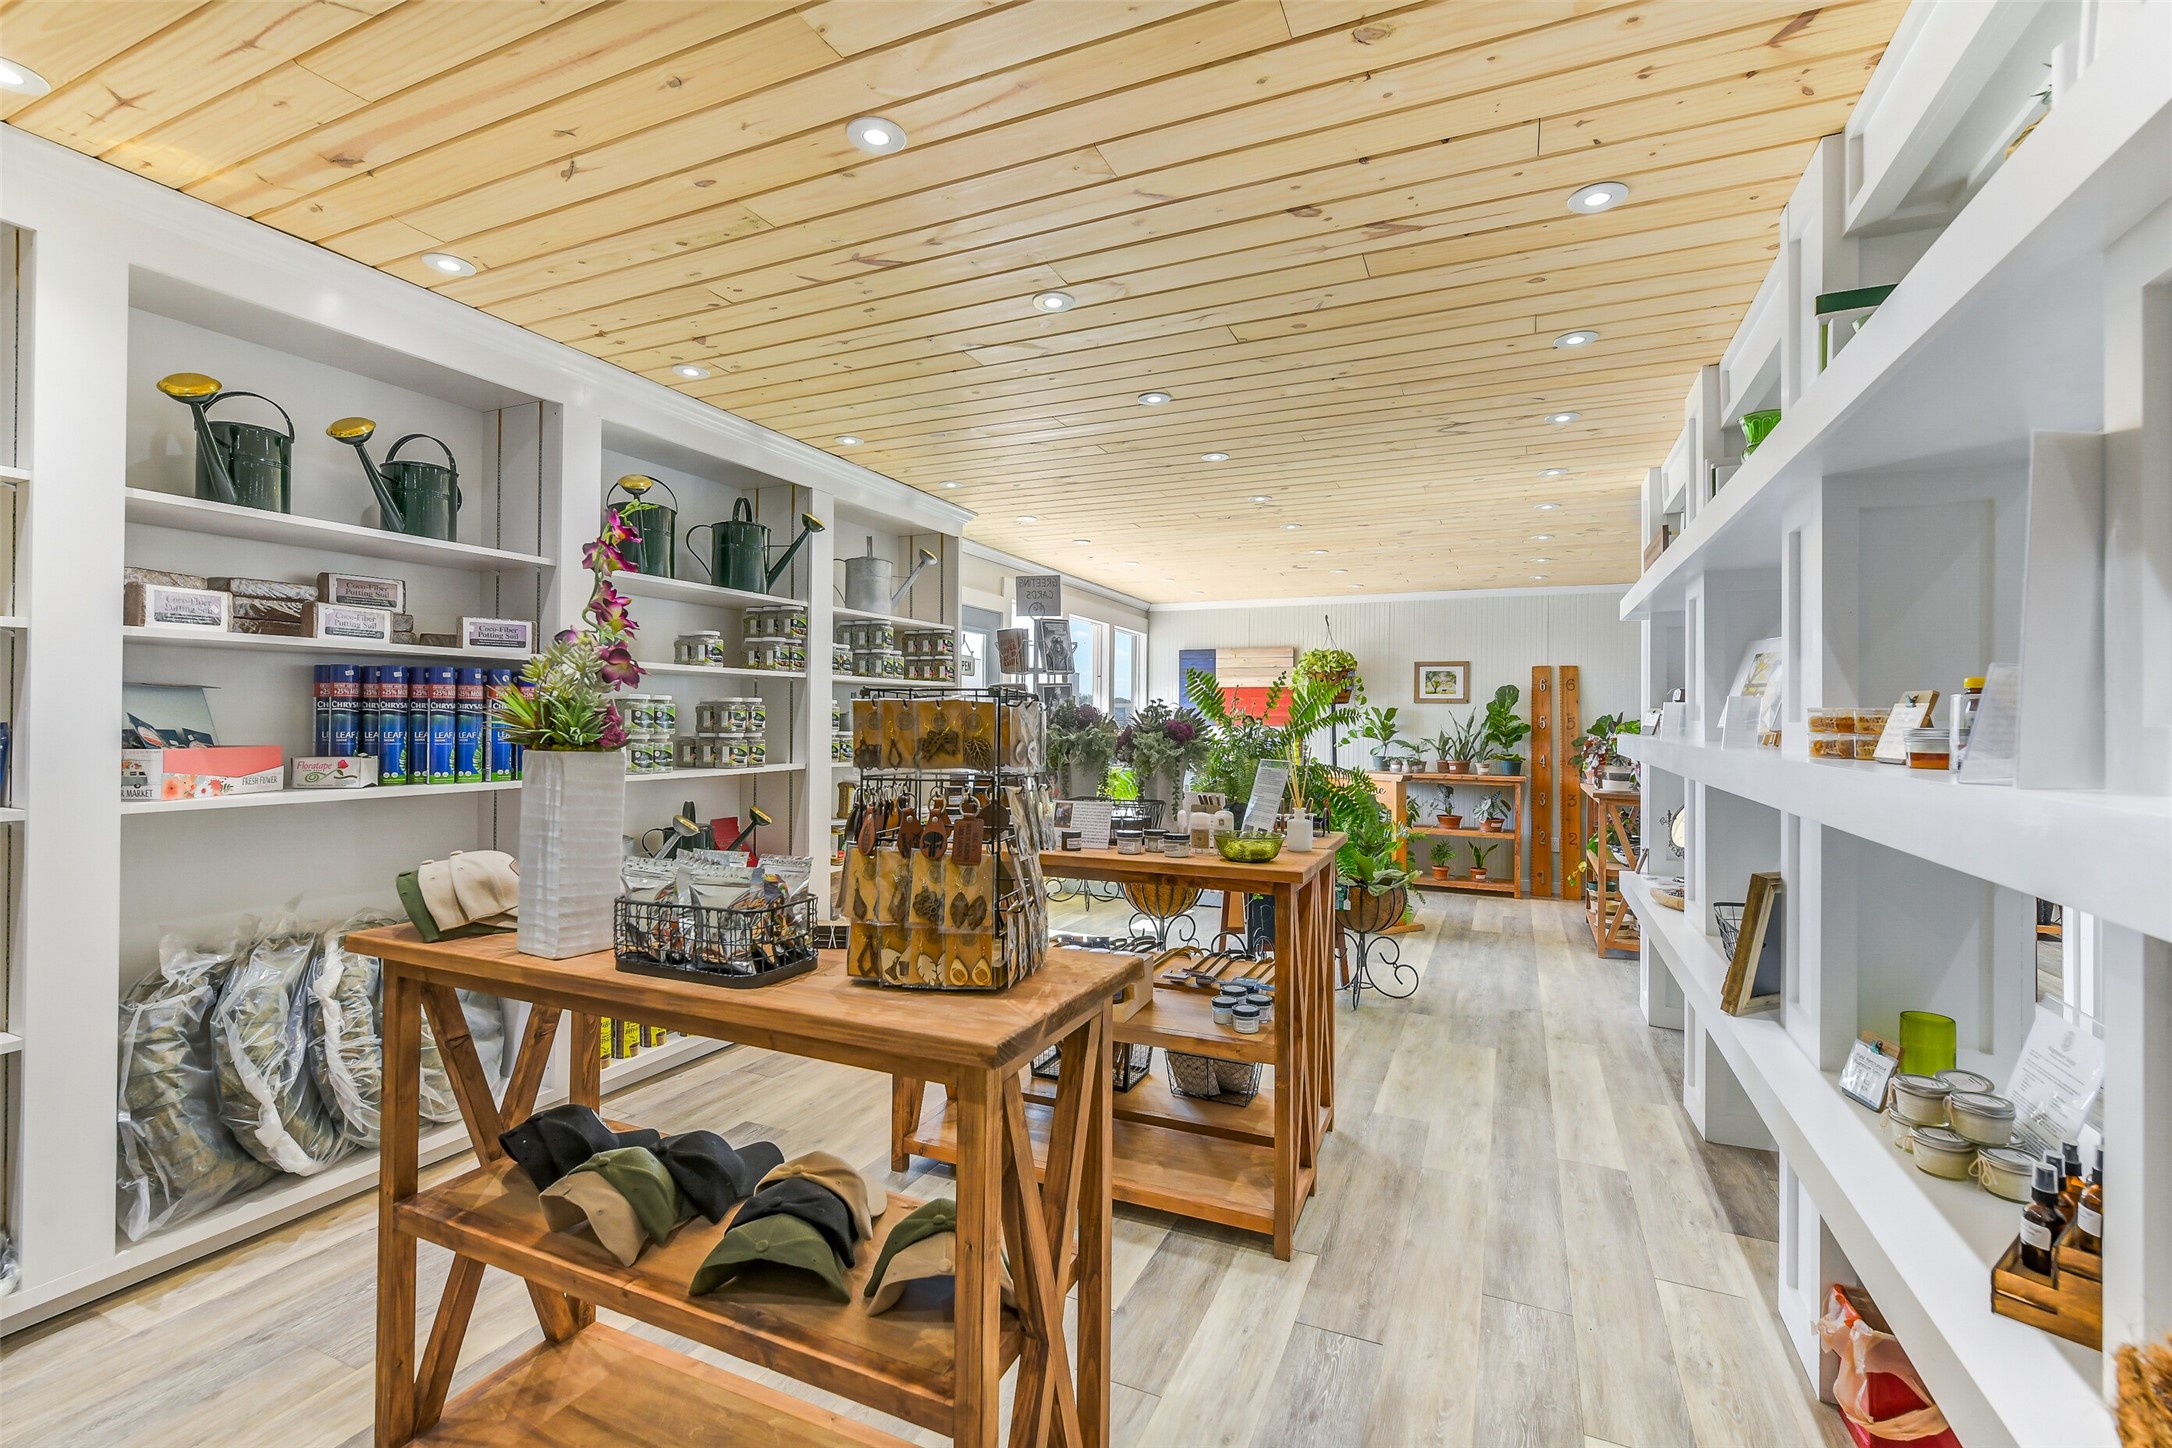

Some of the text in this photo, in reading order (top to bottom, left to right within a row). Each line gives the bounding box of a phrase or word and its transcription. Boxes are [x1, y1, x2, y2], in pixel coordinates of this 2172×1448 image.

[346, 582, 389, 592] Coco-Fiber
[345, 588, 390, 599] Potting Soil
[335, 612, 376, 622] Coco-Fiber
[334, 619, 377, 630] Potting Soil
[478, 625, 519, 634] Coco-Fiber
[478, 631, 504, 640] Potting
[961, 660, 971, 672] PEN
[1539, 678, 1547, 692] 6
[1565, 678, 1576, 692] 6
[1539, 715, 1547, 729] 5
[1566, 716, 1576, 731] 5
[383, 731, 403, 739] LEAF
[296, 760, 333, 772] Floratape
[1539, 754, 1546, 768] 4
[242, 777, 259, 785] FRESH
[126, 789, 153, 798] MARKET
[1539, 792, 1546, 806] 3
[1567, 794, 1578, 808] 3
[1539, 830, 1546, 845] 2
[1568, 832, 1578, 846] 2
